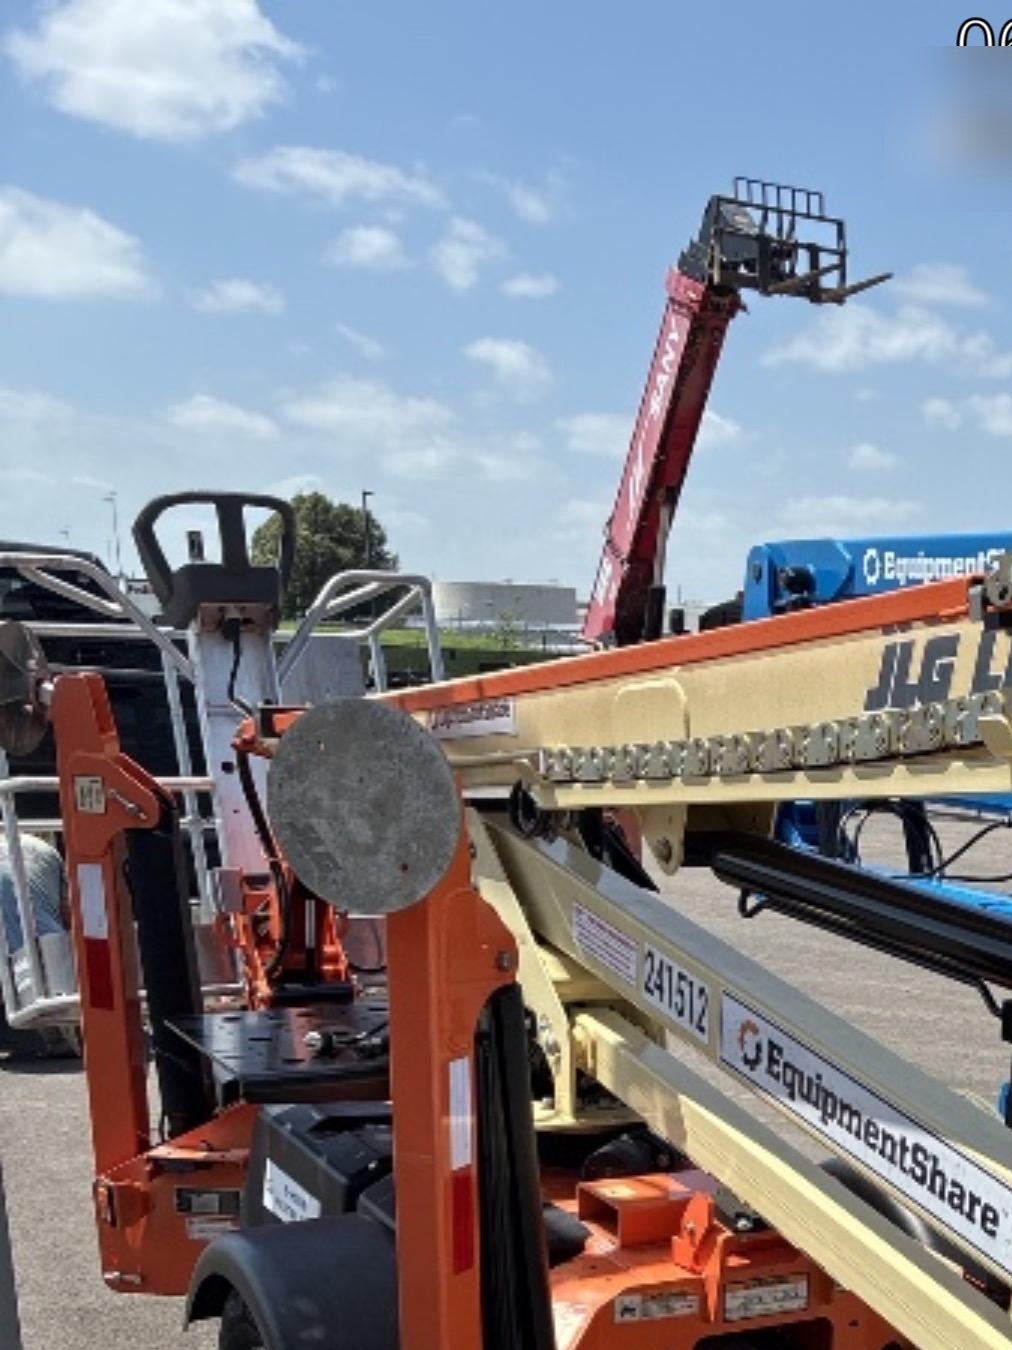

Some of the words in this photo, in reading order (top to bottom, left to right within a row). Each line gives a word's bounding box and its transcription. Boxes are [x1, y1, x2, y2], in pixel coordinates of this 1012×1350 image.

[884, 548, 1006, 585] EquipmentS
[864, 633, 960, 711] JLG
[644, 950, 709, 1035] 241512
[766, 1037, 1001, 1238] EquipmentShare
